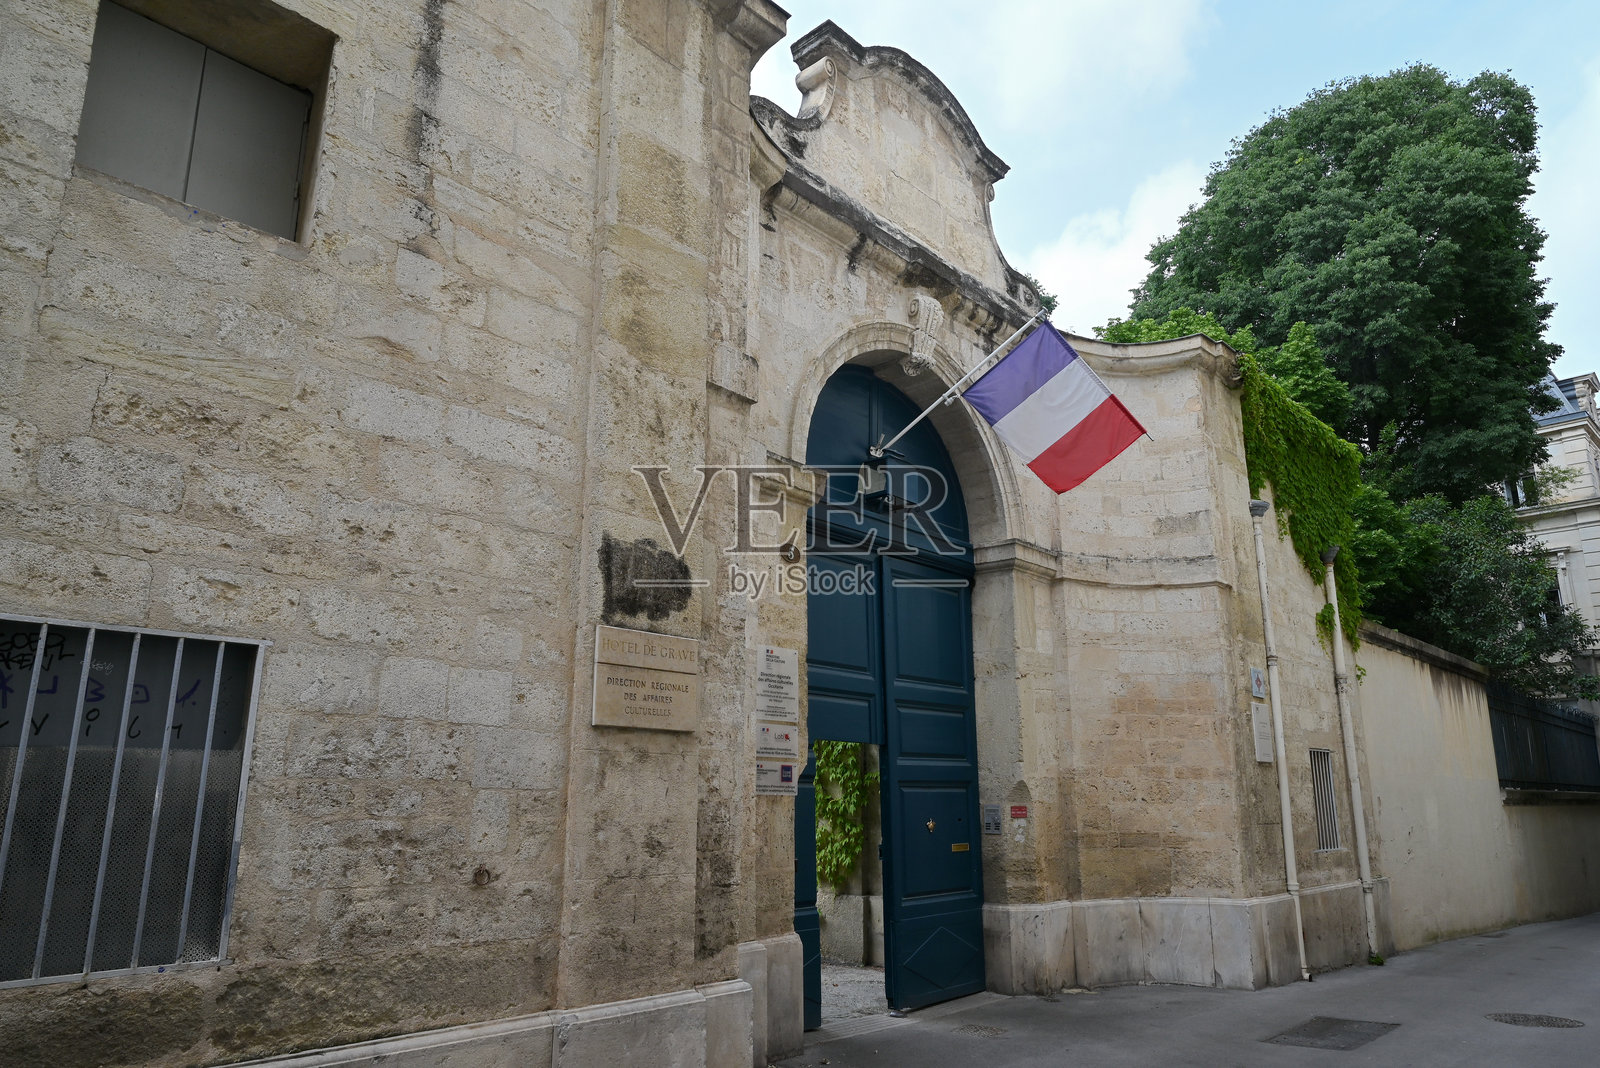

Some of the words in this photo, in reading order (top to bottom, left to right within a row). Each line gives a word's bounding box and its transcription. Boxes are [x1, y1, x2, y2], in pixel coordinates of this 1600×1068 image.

[643, 644, 657, 657] DE
[660, 647, 695, 662] GRAVE
[606, 676, 646, 688] DIRECTION
[623, 692, 637, 701] DES
[643, 694, 673, 704] AFFAIRES
[624, 706, 671, 717] CULTURELLES
